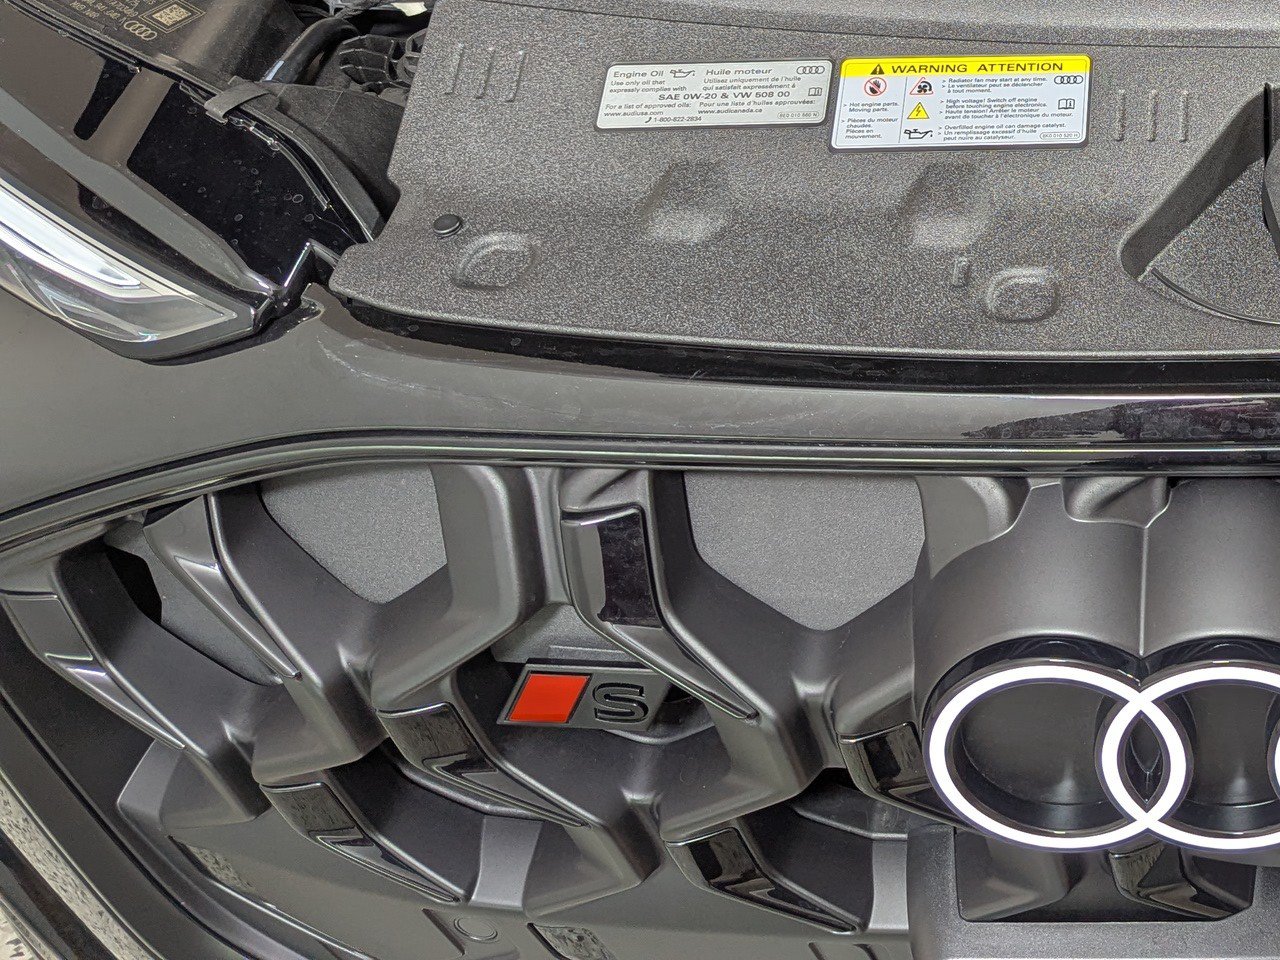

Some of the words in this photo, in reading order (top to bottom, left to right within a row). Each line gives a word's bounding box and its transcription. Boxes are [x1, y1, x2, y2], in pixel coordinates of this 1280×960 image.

[892, 64, 968, 74] WARNING
[977, 62, 1063, 72] ATTENTION
[613, 70, 647, 79] Engine
[592, 682, 649, 724] S
